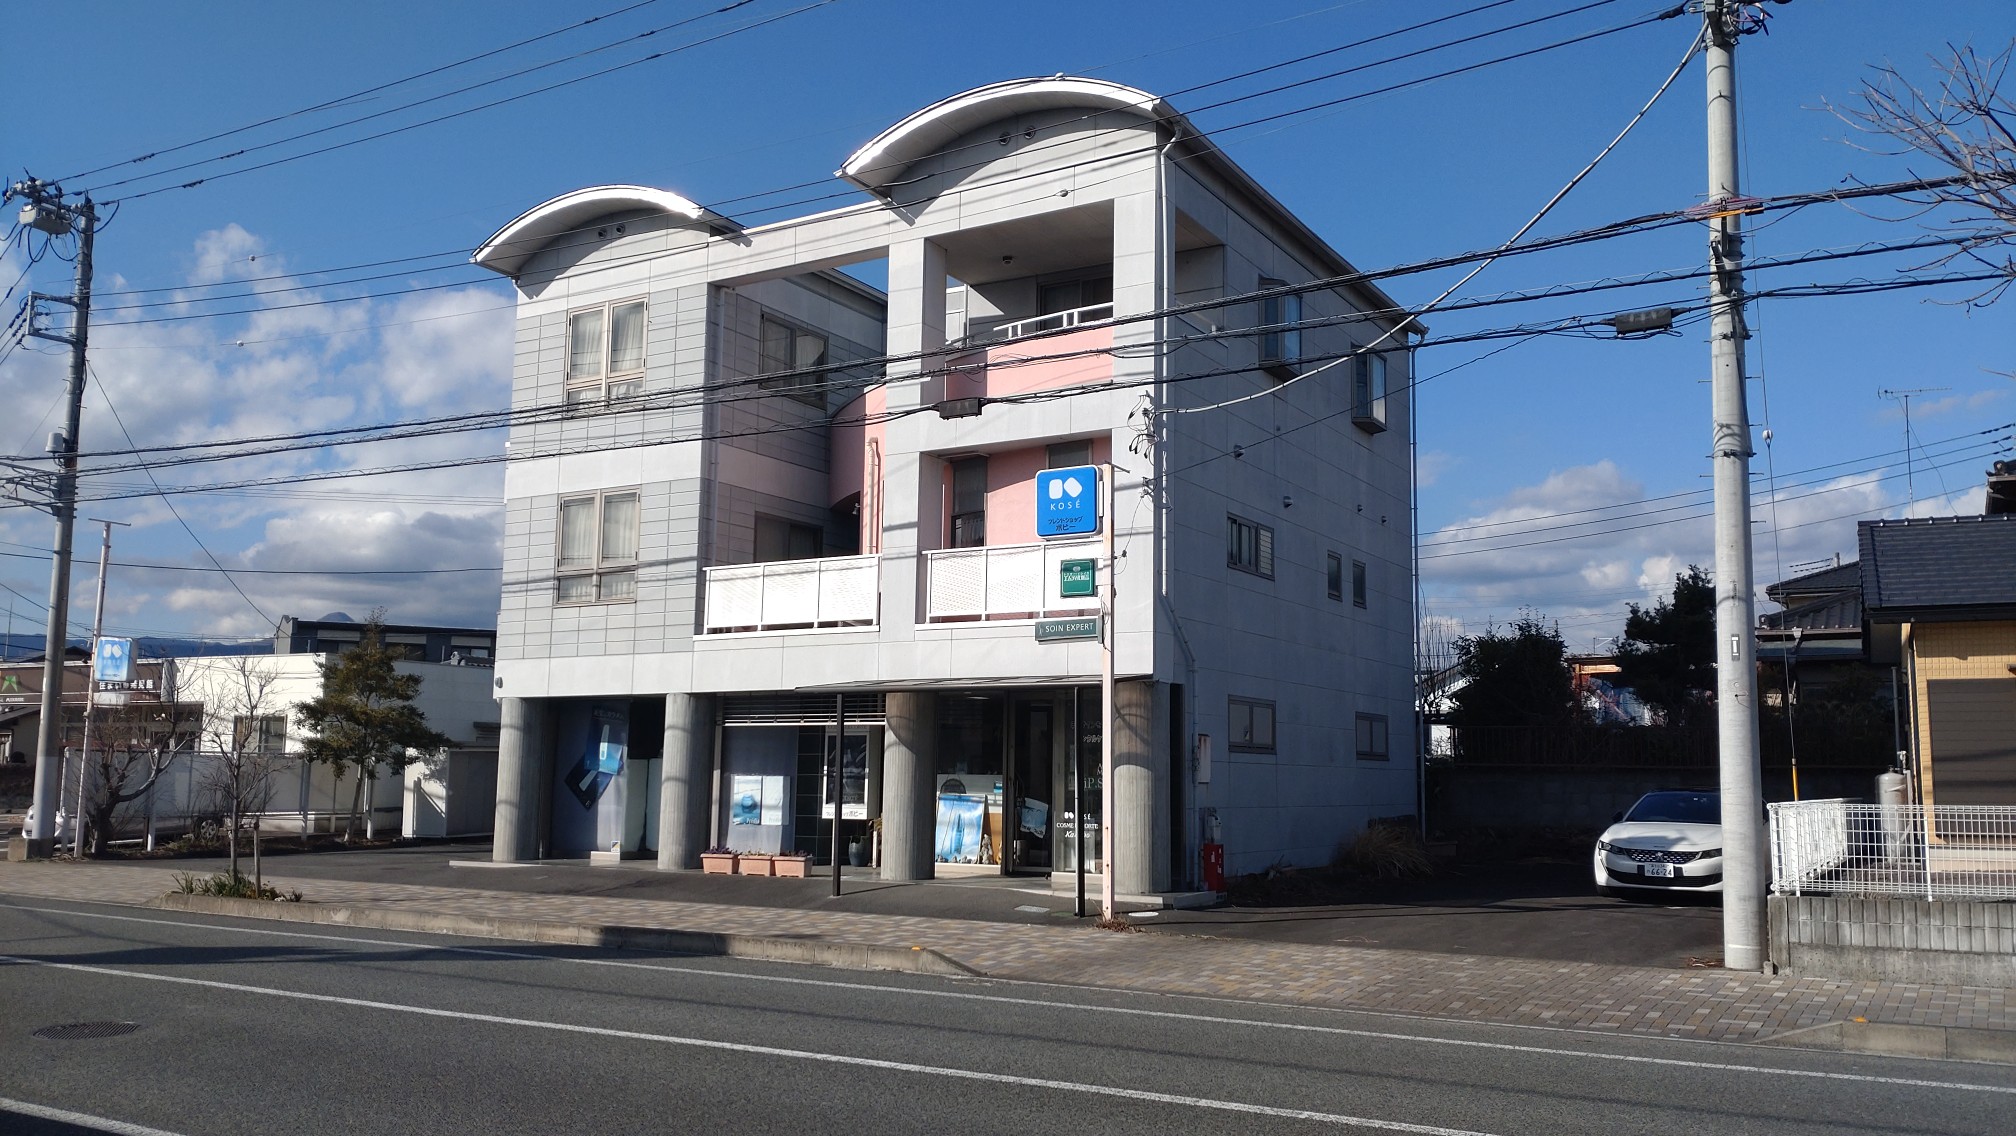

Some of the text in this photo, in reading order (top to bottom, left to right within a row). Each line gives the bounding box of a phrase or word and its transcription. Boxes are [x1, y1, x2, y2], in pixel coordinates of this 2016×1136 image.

[1050, 500, 1081, 511] KOSÉ
[1045, 623, 1094, 633] SOIN EXPERT
